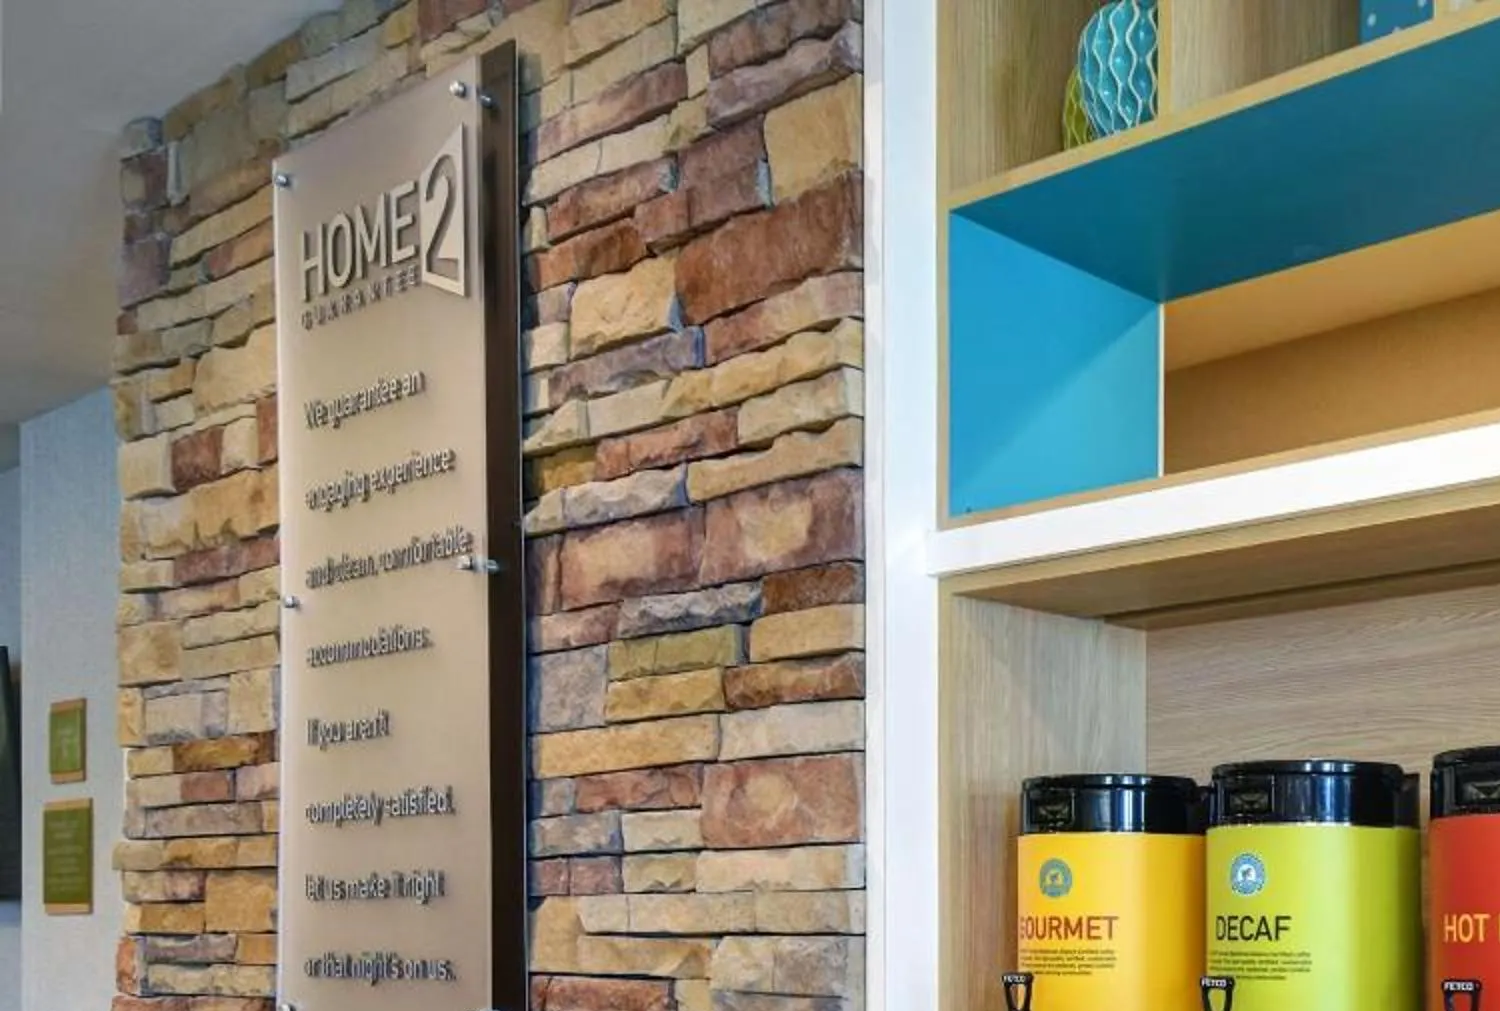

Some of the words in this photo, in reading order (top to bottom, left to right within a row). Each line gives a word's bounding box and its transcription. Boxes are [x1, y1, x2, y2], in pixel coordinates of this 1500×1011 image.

[328, 376, 401, 429] guarantee
[402, 370, 426, 397] an
[370, 449, 456, 495] experience
[319, 720, 346, 751] you
[306, 791, 384, 828] completely
[325, 877, 346, 900] us
[346, 872, 390, 899] make
[1215, 915, 1292, 941] DECAF
[1443, 913, 1489, 944] HOT
[322, 952, 352, 979] that
[403, 958, 428, 979] on
